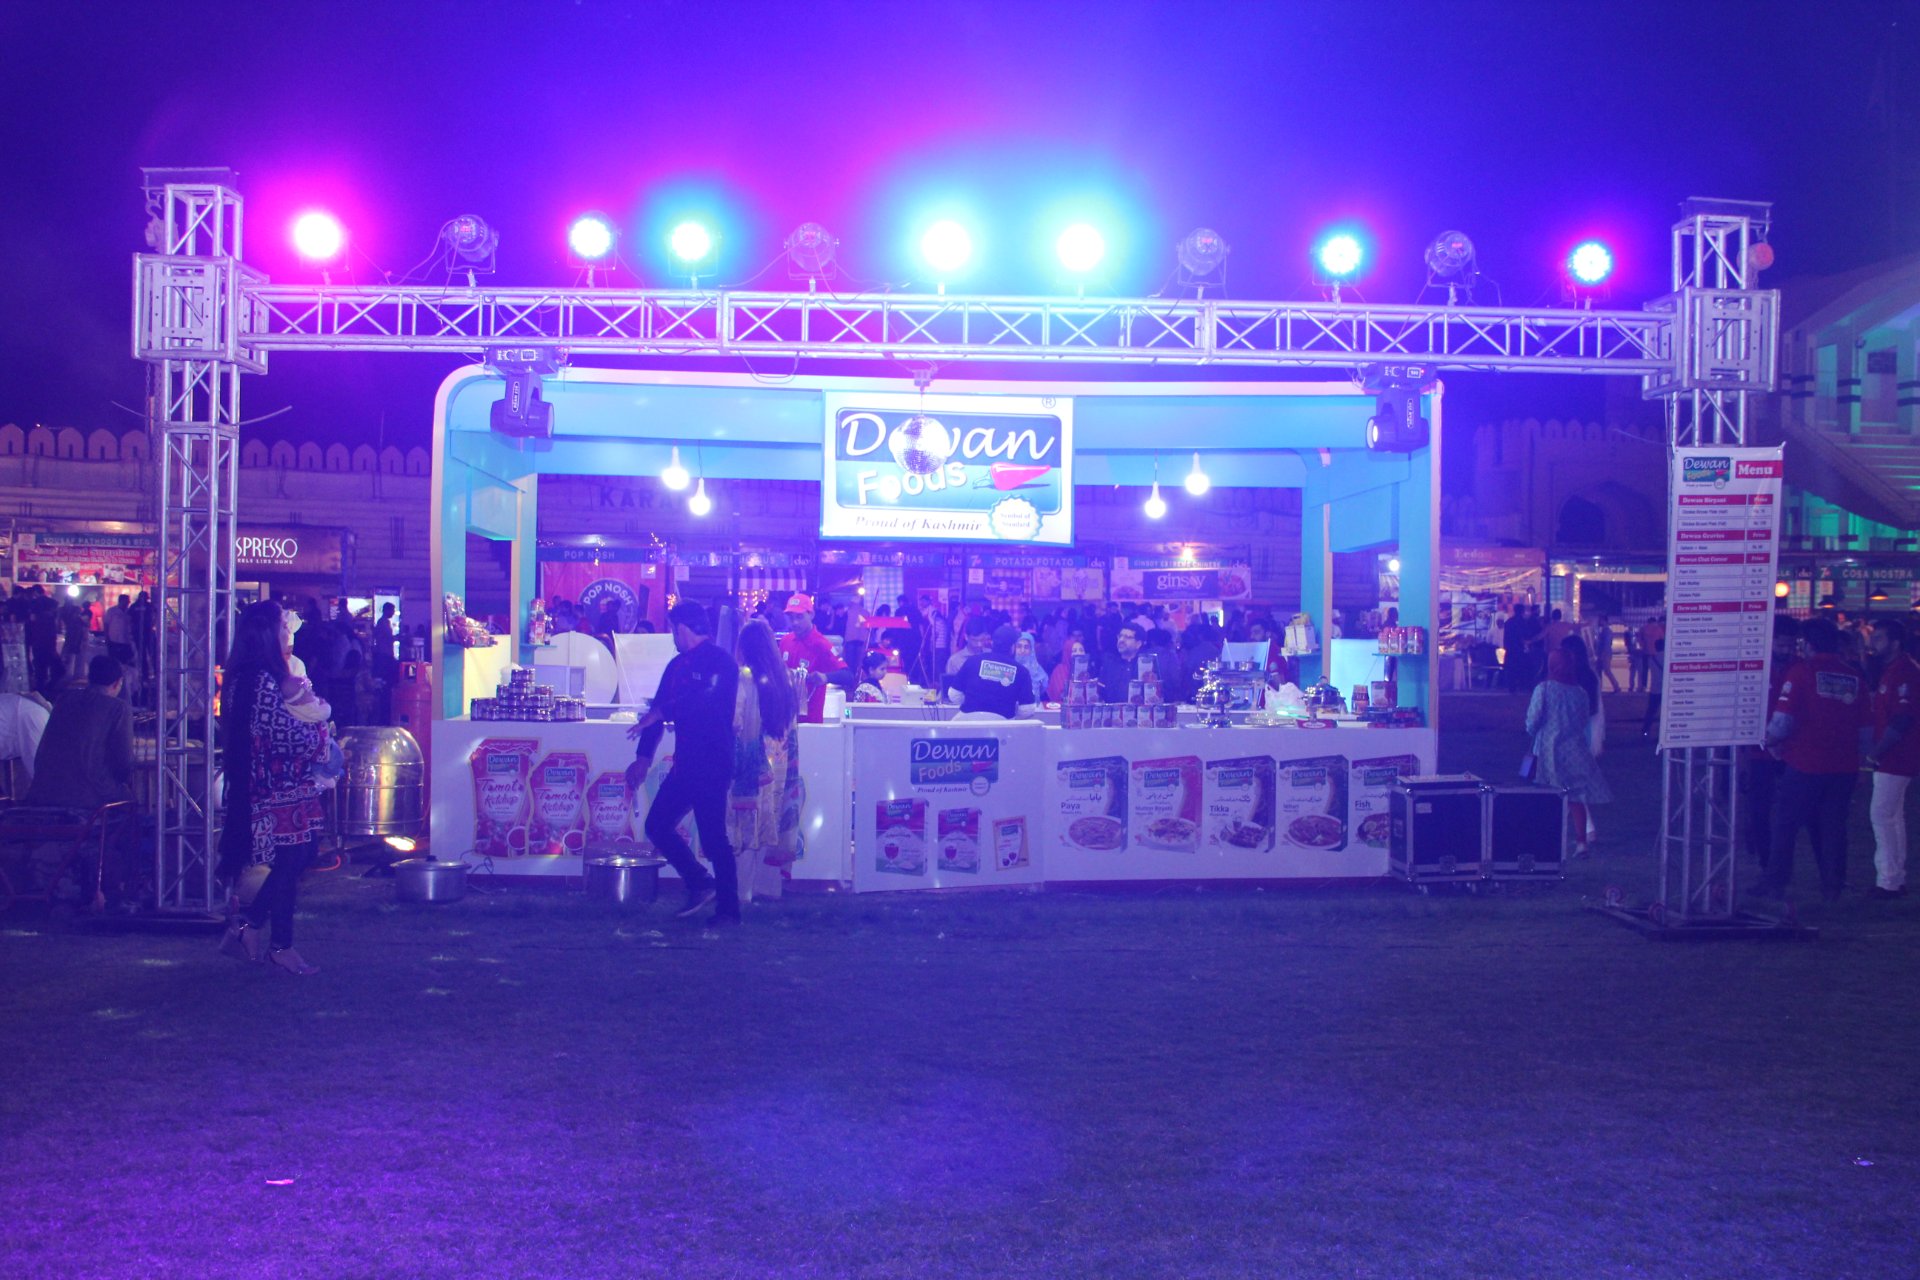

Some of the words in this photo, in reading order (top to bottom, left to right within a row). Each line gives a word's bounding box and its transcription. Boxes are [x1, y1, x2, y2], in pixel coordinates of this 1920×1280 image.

[1684, 457, 1728, 469] Dewan
[1738, 464, 1774, 476] Menu
[855, 515, 898, 529] Proud
[900, 517, 917, 531] of
[921, 518, 983, 532] Kashmir
[236, 537, 298, 558] SPRESSO
[564, 551, 584, 559] POP
[995, 557, 1033, 567] POTATO
[1842, 568, 1869, 579] COSA
[1872, 569, 1912, 579] NOSTRA
[583, 584, 602, 605] POP
[604, 583, 634, 606] NOSH
[913, 741, 997, 761] Dewan
[918, 760, 962, 783] Foods
[1061, 802, 1081, 811] Paya
[1210, 805, 1229, 813] Tikka
[1355, 800, 1371, 809] Fish
